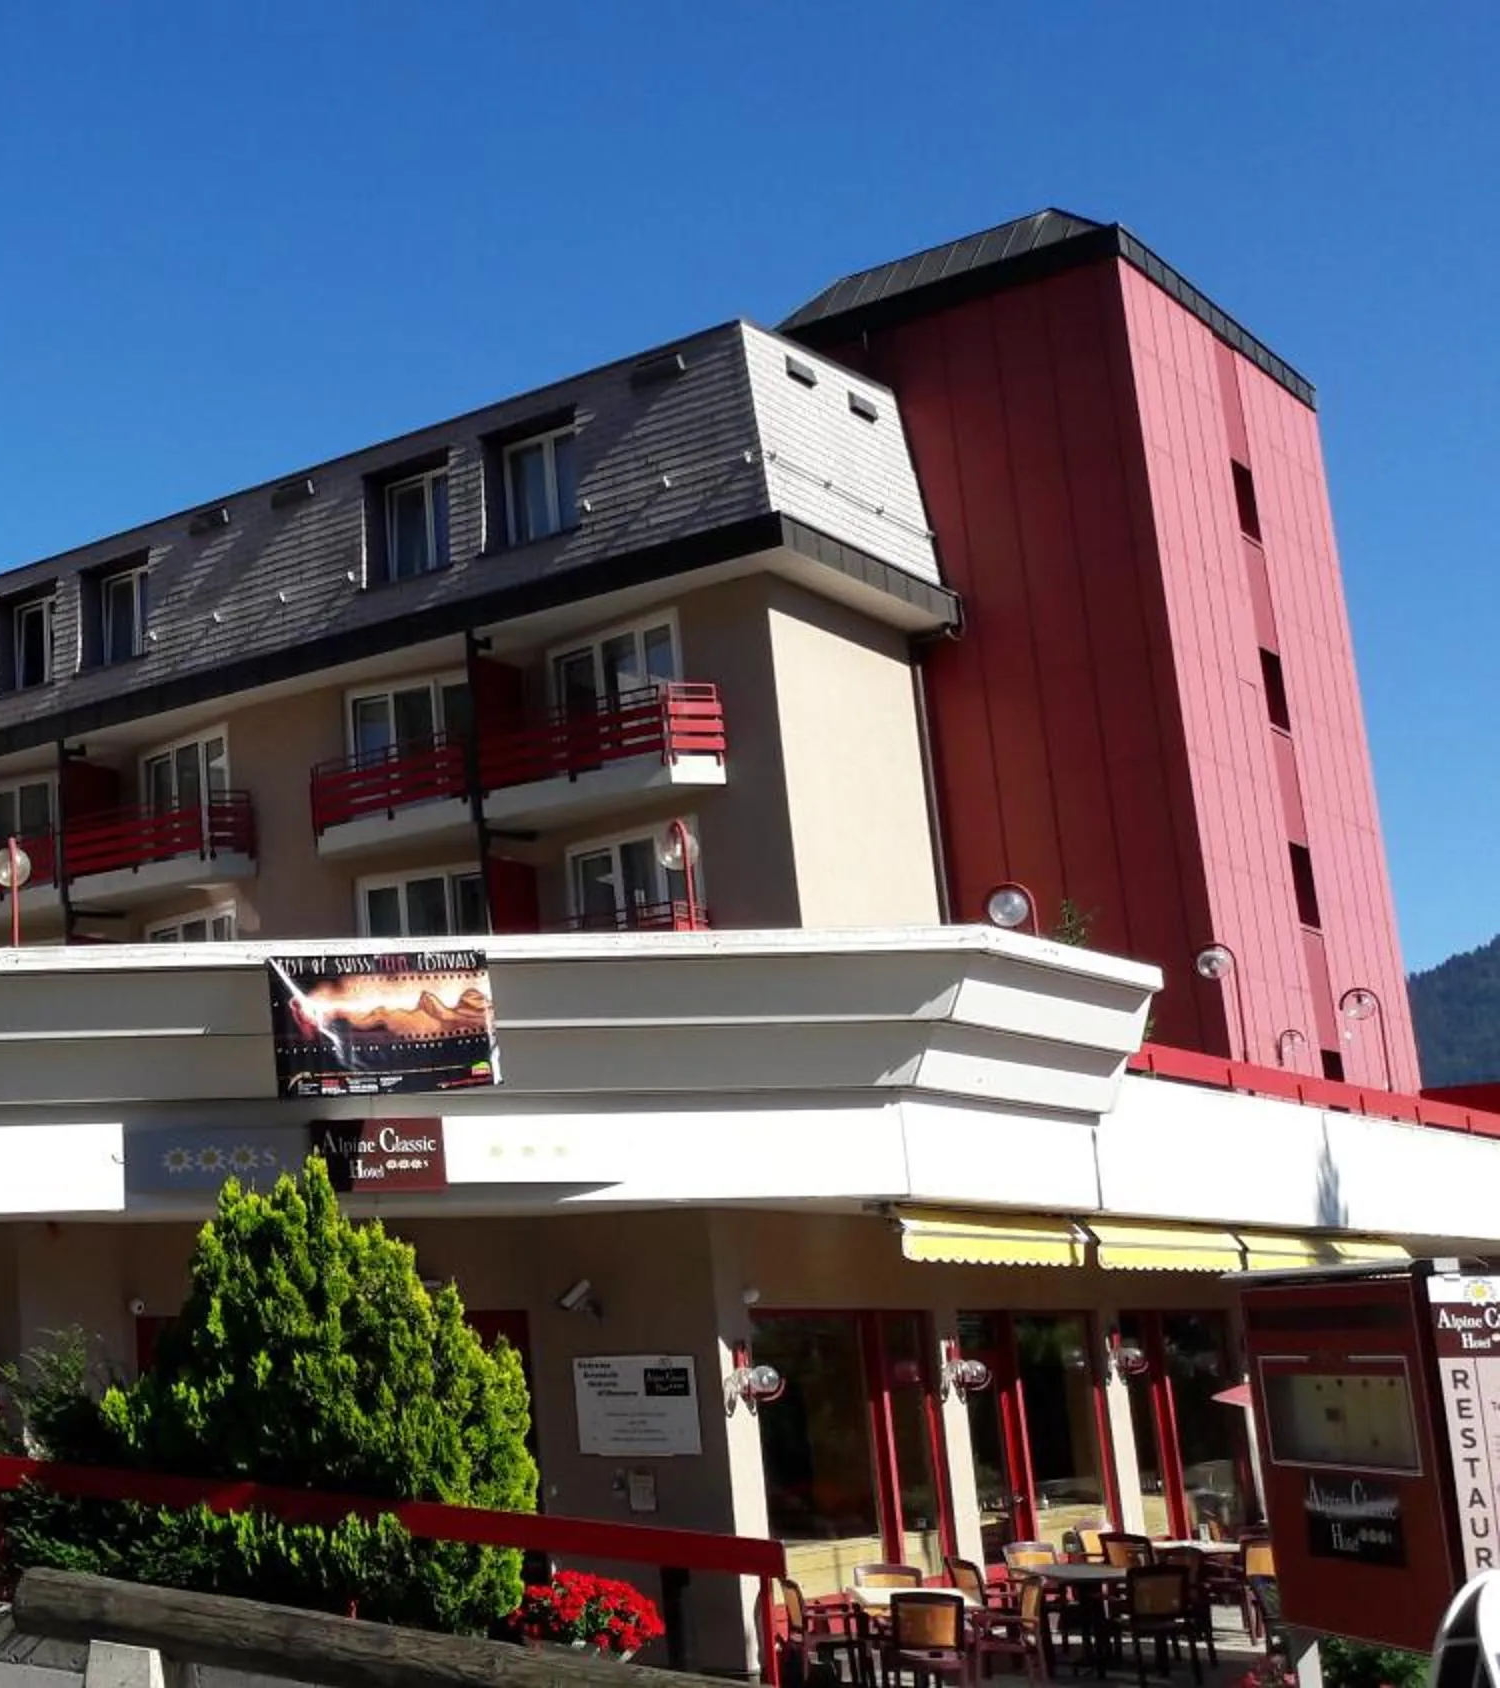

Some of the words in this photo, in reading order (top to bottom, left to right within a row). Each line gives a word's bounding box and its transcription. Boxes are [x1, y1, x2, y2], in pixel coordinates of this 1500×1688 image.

[417, 952, 477, 971] FESTIVALS
[322, 1130, 376, 1158] Alpine
[380, 1127, 437, 1153] Classic
[349, 1159, 385, 1179] Hotel
[1438, 1307, 1483, 1332] Alpine
